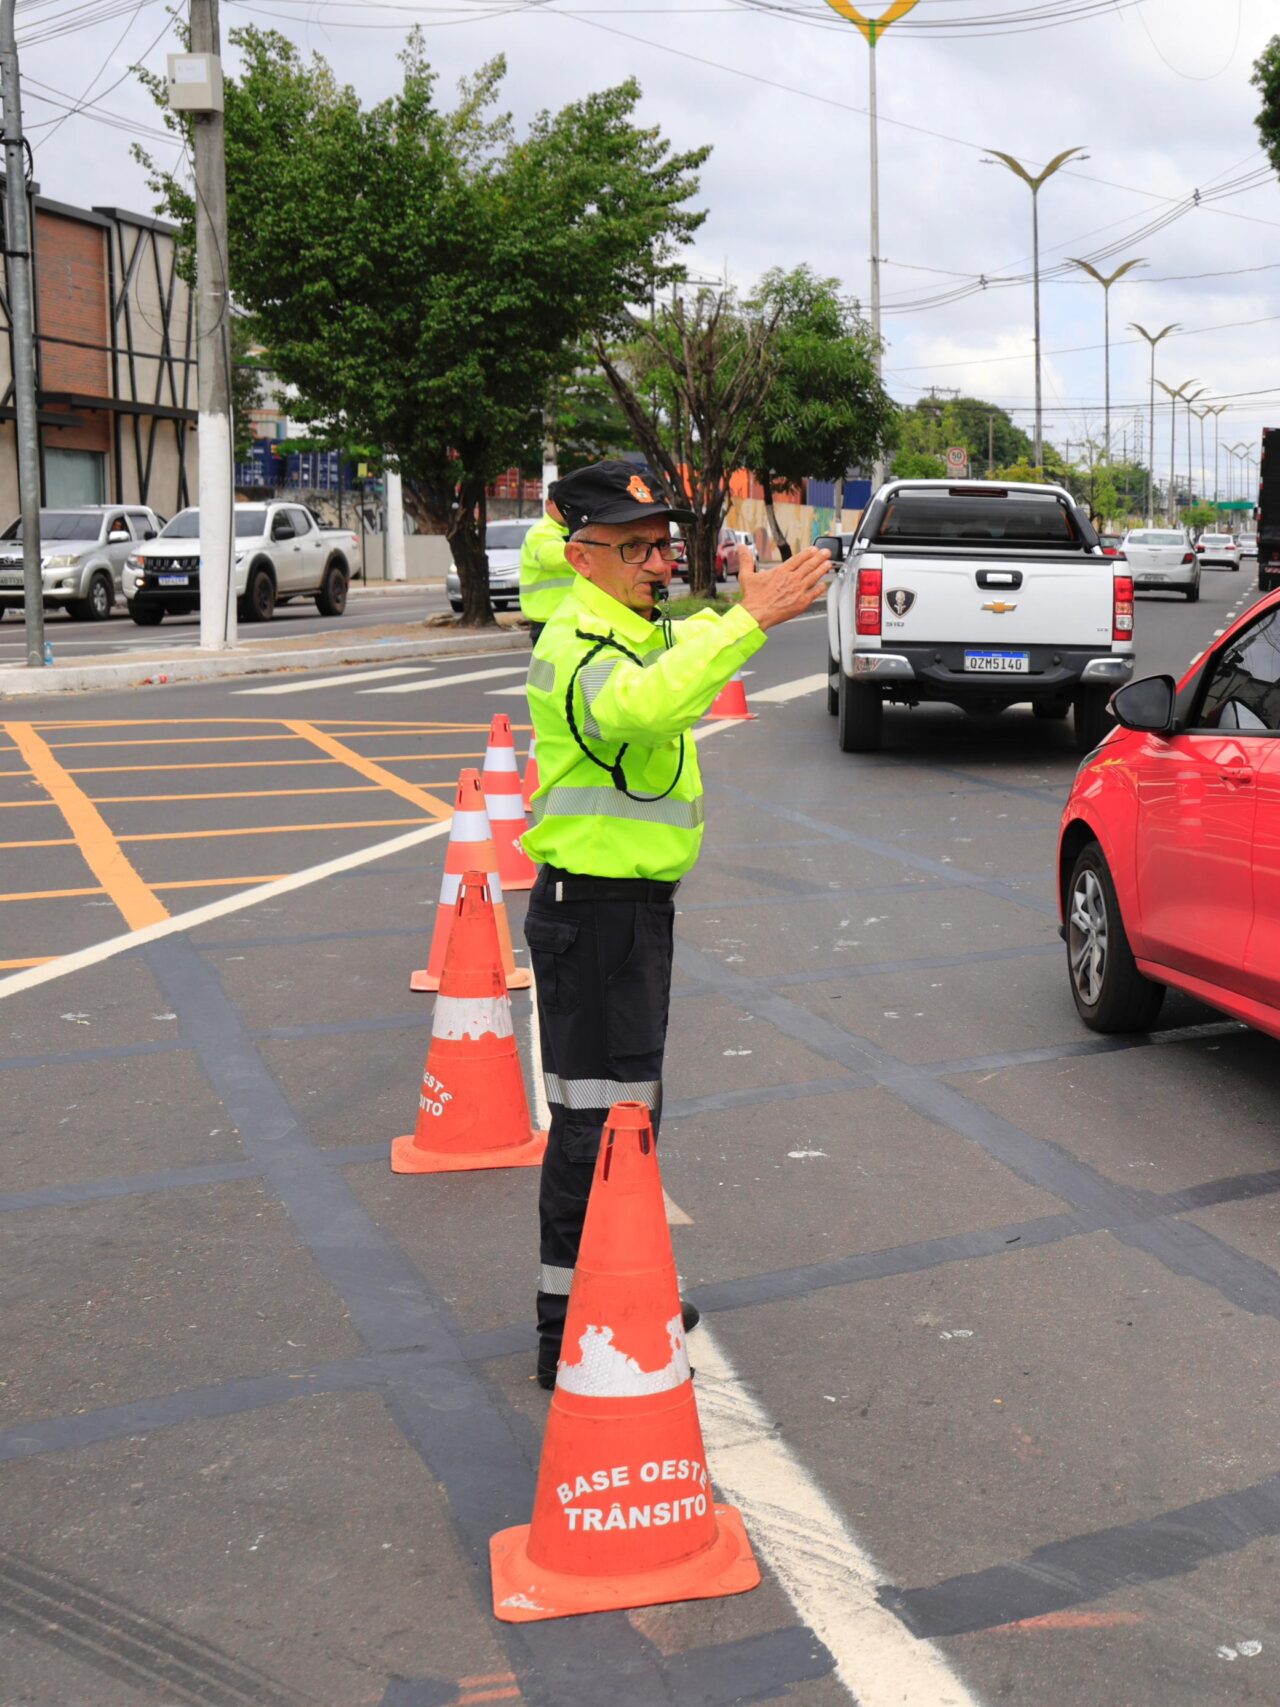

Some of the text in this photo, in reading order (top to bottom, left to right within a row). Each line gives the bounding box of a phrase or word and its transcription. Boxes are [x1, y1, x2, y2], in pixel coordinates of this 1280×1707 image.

[556, 1459, 707, 1505] BASE OESTE
[563, 1493, 707, 1531] TRÂNSITO
